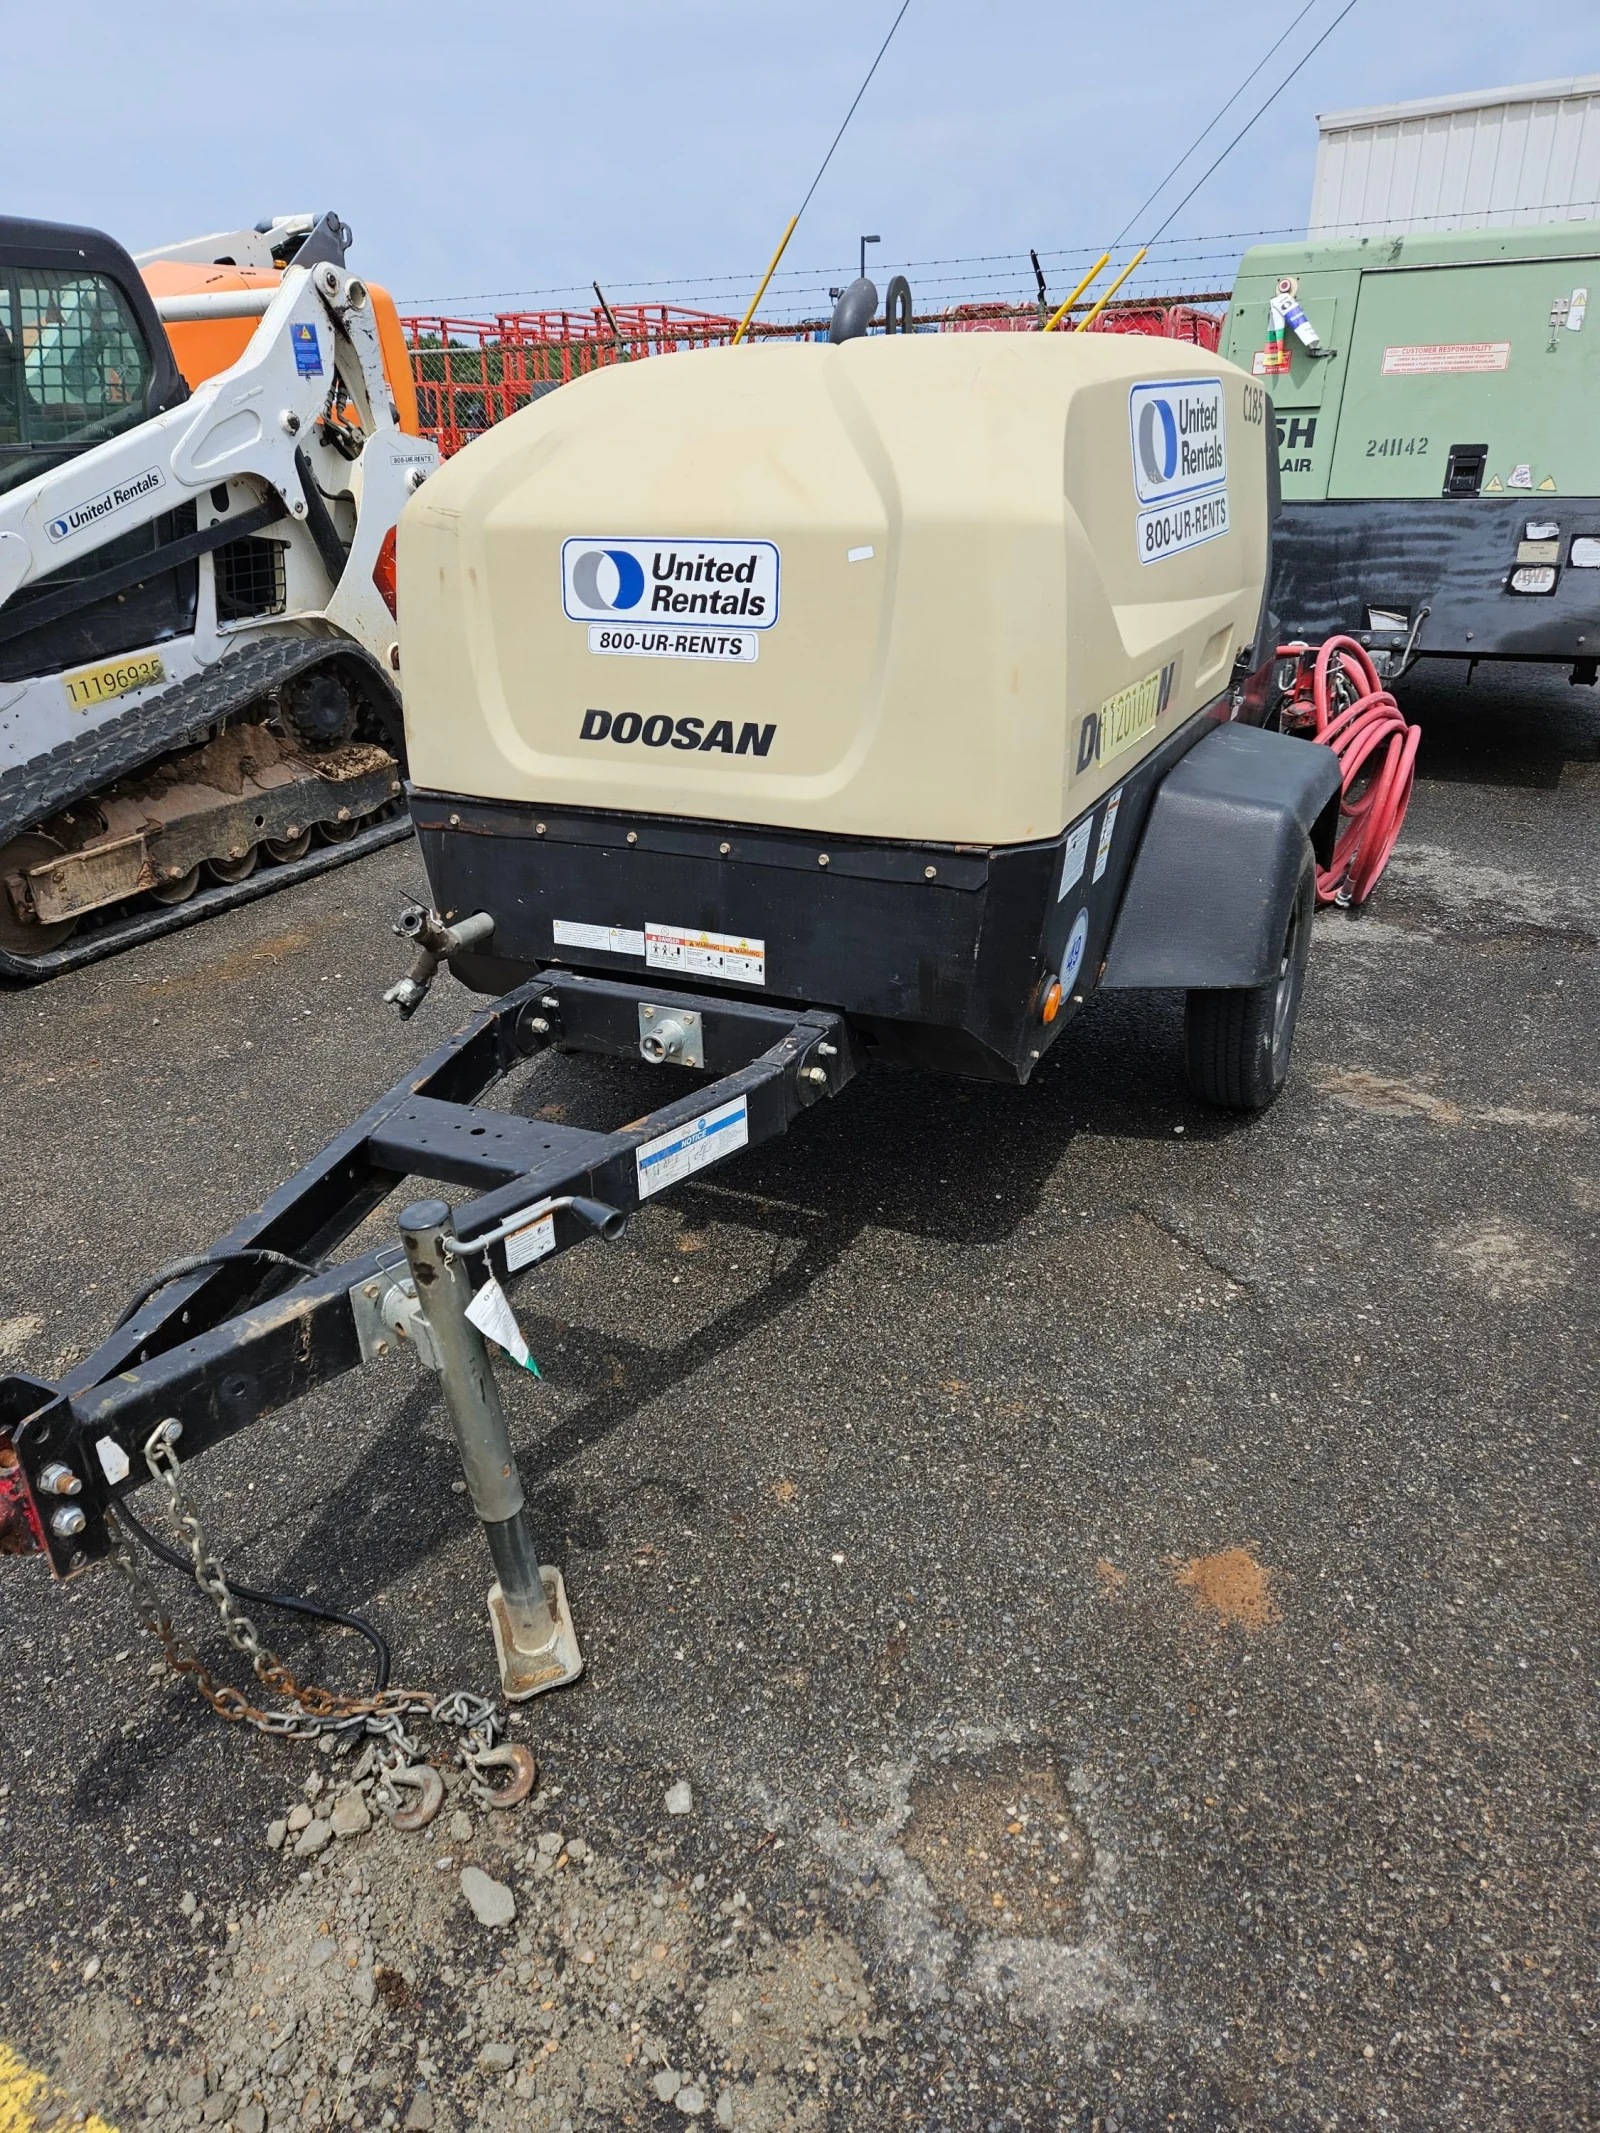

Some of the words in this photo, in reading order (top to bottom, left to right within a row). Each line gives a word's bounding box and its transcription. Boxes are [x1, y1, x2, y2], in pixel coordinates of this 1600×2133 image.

[1401, 347, 1437, 355] CUSTOMER
[1438, 345, 1493, 354] RESPONSIBILITY
[1179, 396, 1218, 435] United
[1243, 384, 1263, 426] C185
[1181, 435, 1223, 476] Rentals
[1366, 437, 1429, 457] 241142
[1280, 458, 1312, 472] AIR
[69, 496, 113, 528] United
[113, 474, 159, 505] Rentals
[1145, 497, 1226, 551] 800-UR-RENTS
[652, 552, 758, 583] United
[650, 584, 766, 616] Rentals
[599, 632, 743, 655] 800-UR-RENTS
[1101, 674, 1159, 752] 11201077
[579, 709, 777, 757] DOOSAN
[657, 936, 680, 944] DANGER
[694, 941, 720, 950] WARNING
[735, 948, 760, 957] WARNING
[681, 1129, 707, 1148] NOTICE
